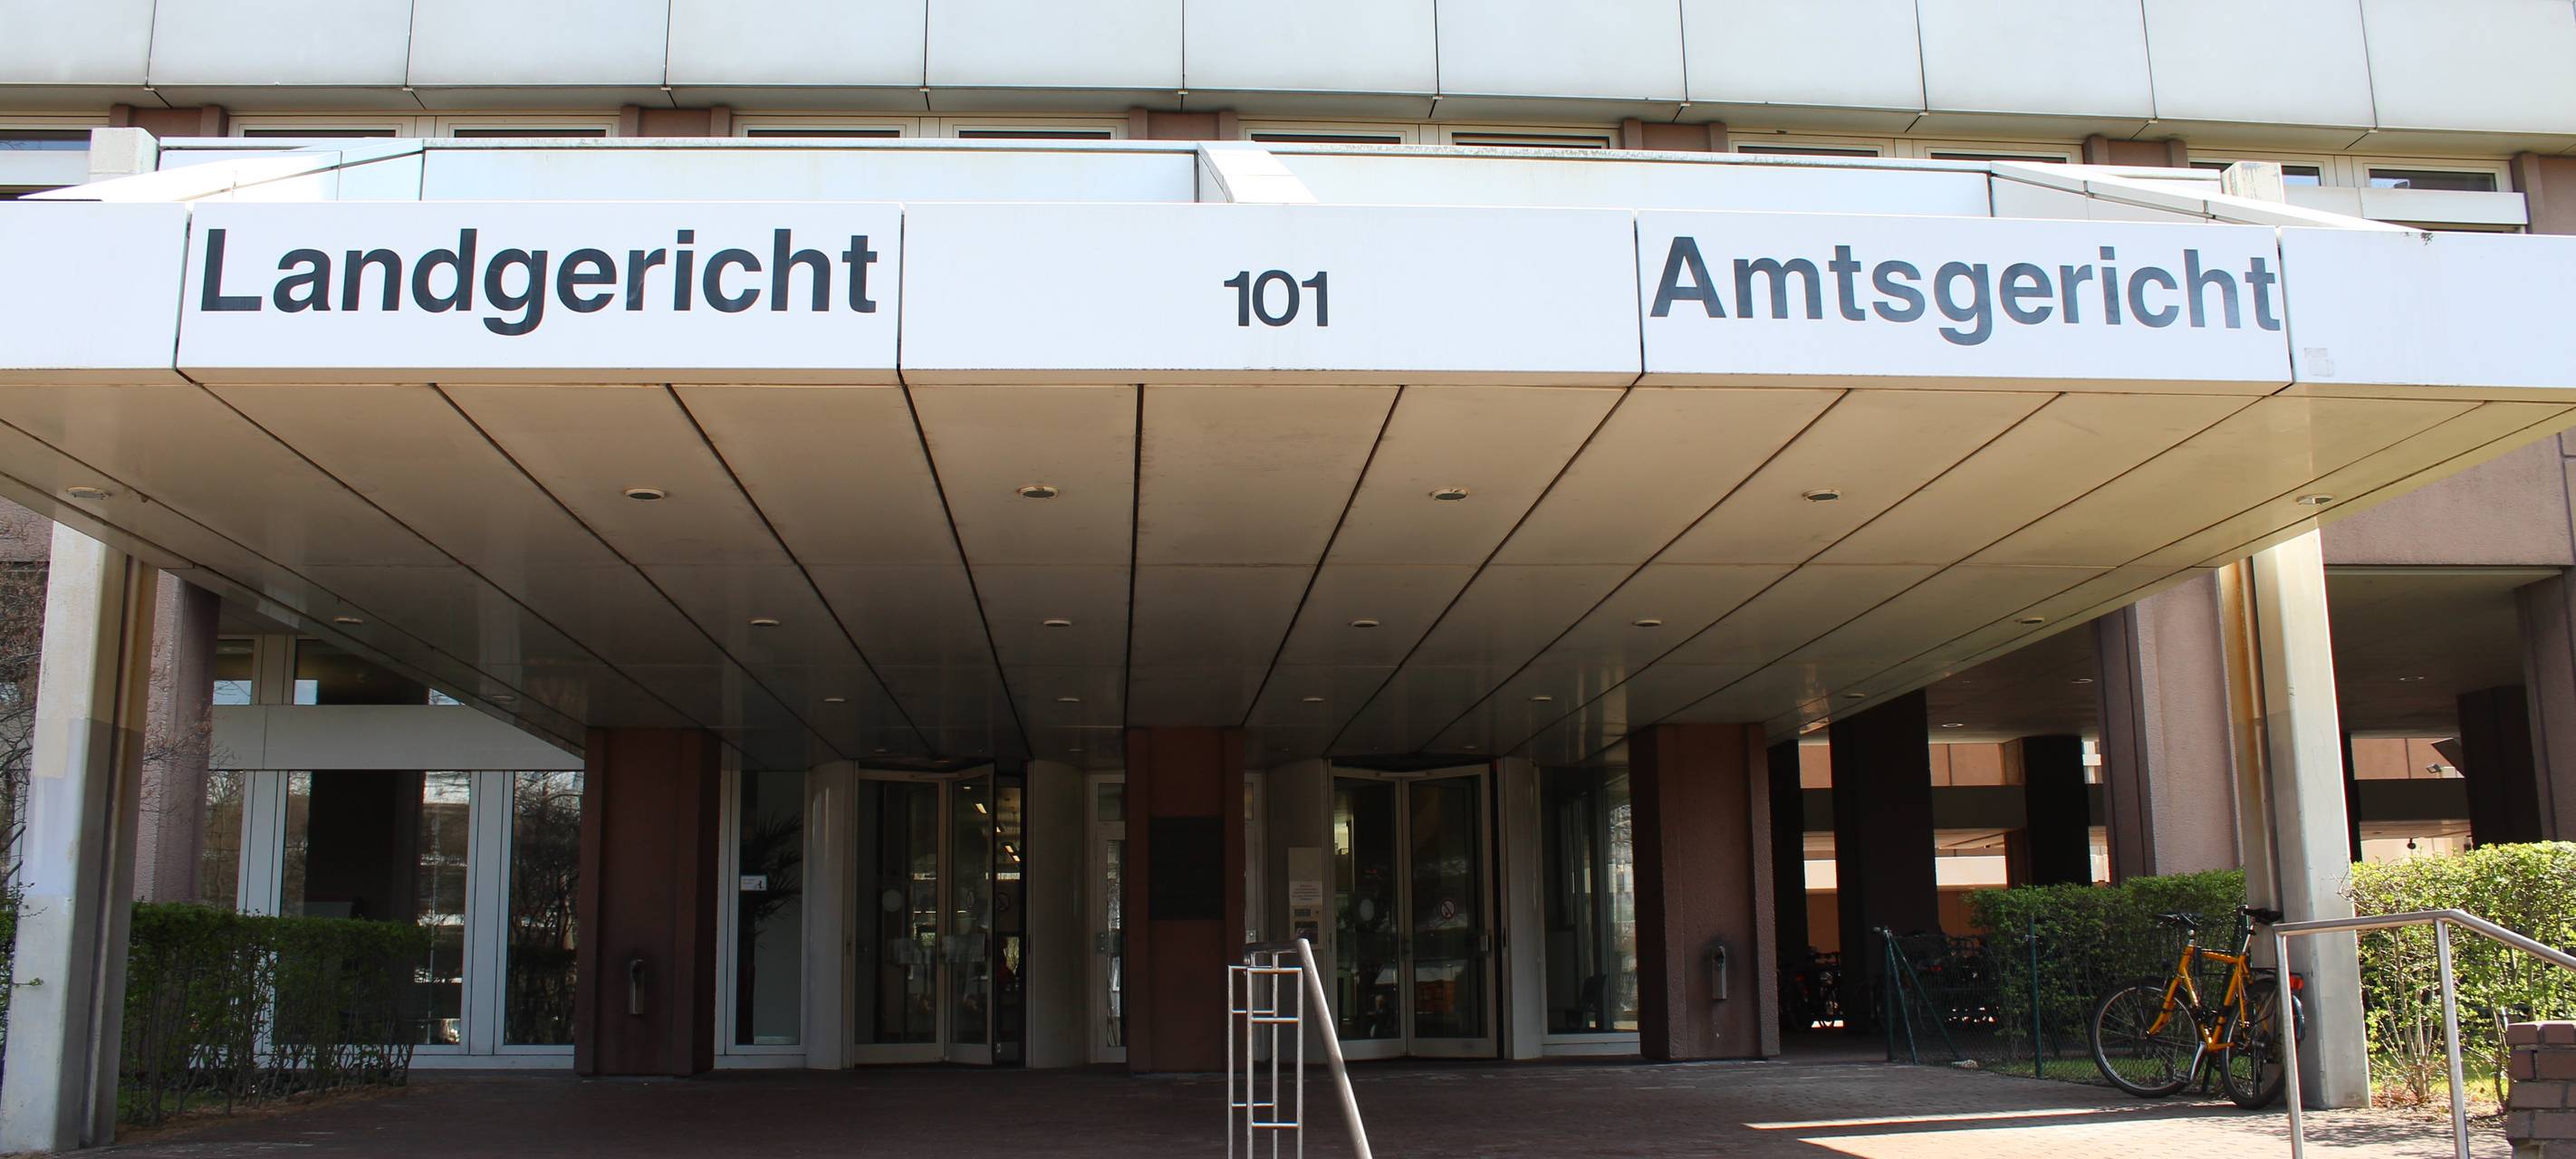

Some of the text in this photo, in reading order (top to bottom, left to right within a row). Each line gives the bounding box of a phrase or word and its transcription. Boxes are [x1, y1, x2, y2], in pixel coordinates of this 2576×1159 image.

[200, 228, 879, 337] Landgericht
[1224, 270, 1328, 327] 101
[1649, 235, 2281, 347] Amtsgericht
